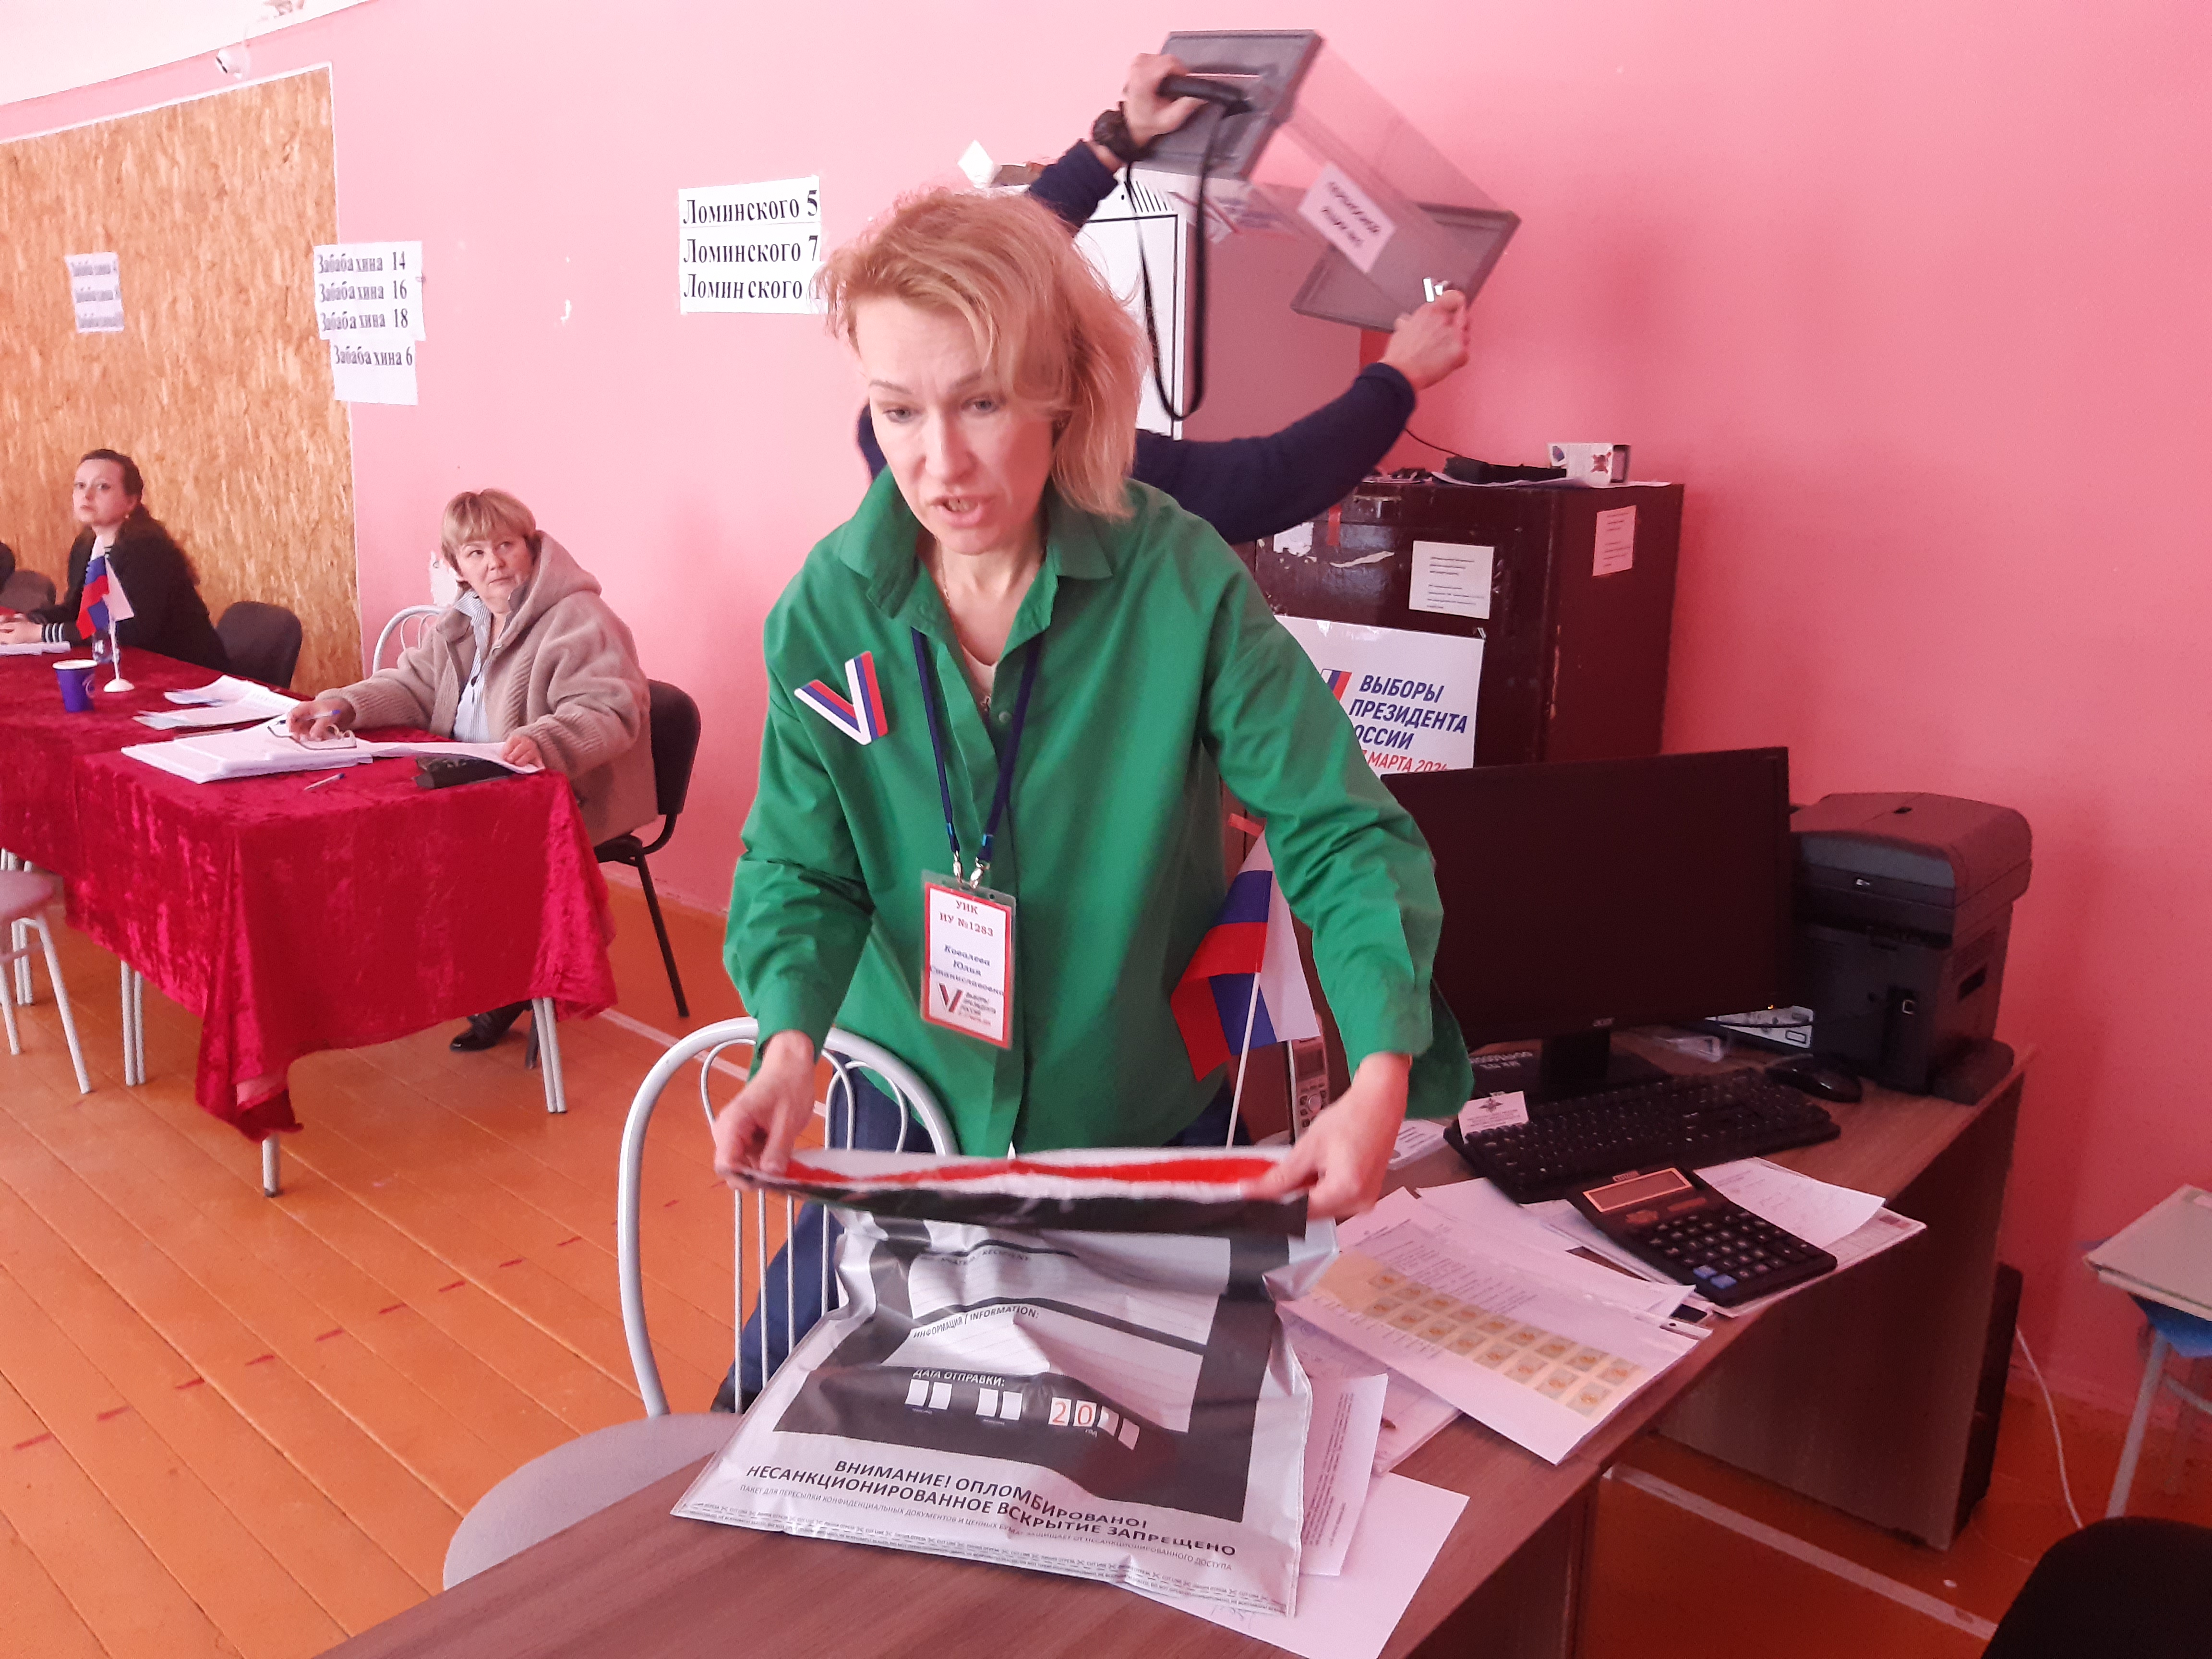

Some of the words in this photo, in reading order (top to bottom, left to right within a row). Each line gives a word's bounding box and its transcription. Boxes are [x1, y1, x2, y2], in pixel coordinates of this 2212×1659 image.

[683, 198, 800, 225] Ломинского
[806, 189, 818, 216] 5
[393, 251, 406, 270] 14
[684, 238, 801, 263] Ломинского
[808, 235, 818, 261] 7
[393, 279, 408, 299] 16
[684, 274, 802, 299] Ломинского
[394, 308, 409, 328] 18
[406, 346, 413, 366] 6
[1359, 674, 1444, 703] ВЫБОРЫ
[1349, 698, 1468, 733] ПРЕЗИДЕНТА
[1354, 724, 1414, 750] ОССИИ
[1367, 751, 1413, 772] МАРТА
[913, 1316, 963, 1338] ИНФОРМАЦИЯ
[970, 1305, 1039, 1321] INFORMATION:
[913, 1369, 941, 1378] ДАТА
[944, 1371, 1005, 1387] ОТПРАВКИ:
[1052, 1400, 1093, 1425] 20
[834, 1460, 952, 1488] ВНИМАНИЕ!
[746, 1466, 994, 1514] НЕСАНКЦИОНИРОВАННОЕ
[997, 1502, 1102, 1533] ВСКРЫТИЕ
[1107, 1527, 1236, 1556] ЗАПРЕЩЕНО
[779, 1490, 821, 1501] ПЕРЕСЫЛКИ
[822, 1496, 903, 1515] КОНФИДЕНЦИАЛЬНЫХ
[904, 1509, 956, 1522] ДОКУМЕНТОВ
[1195, 1558, 1232, 1570] ДОСТУПА
